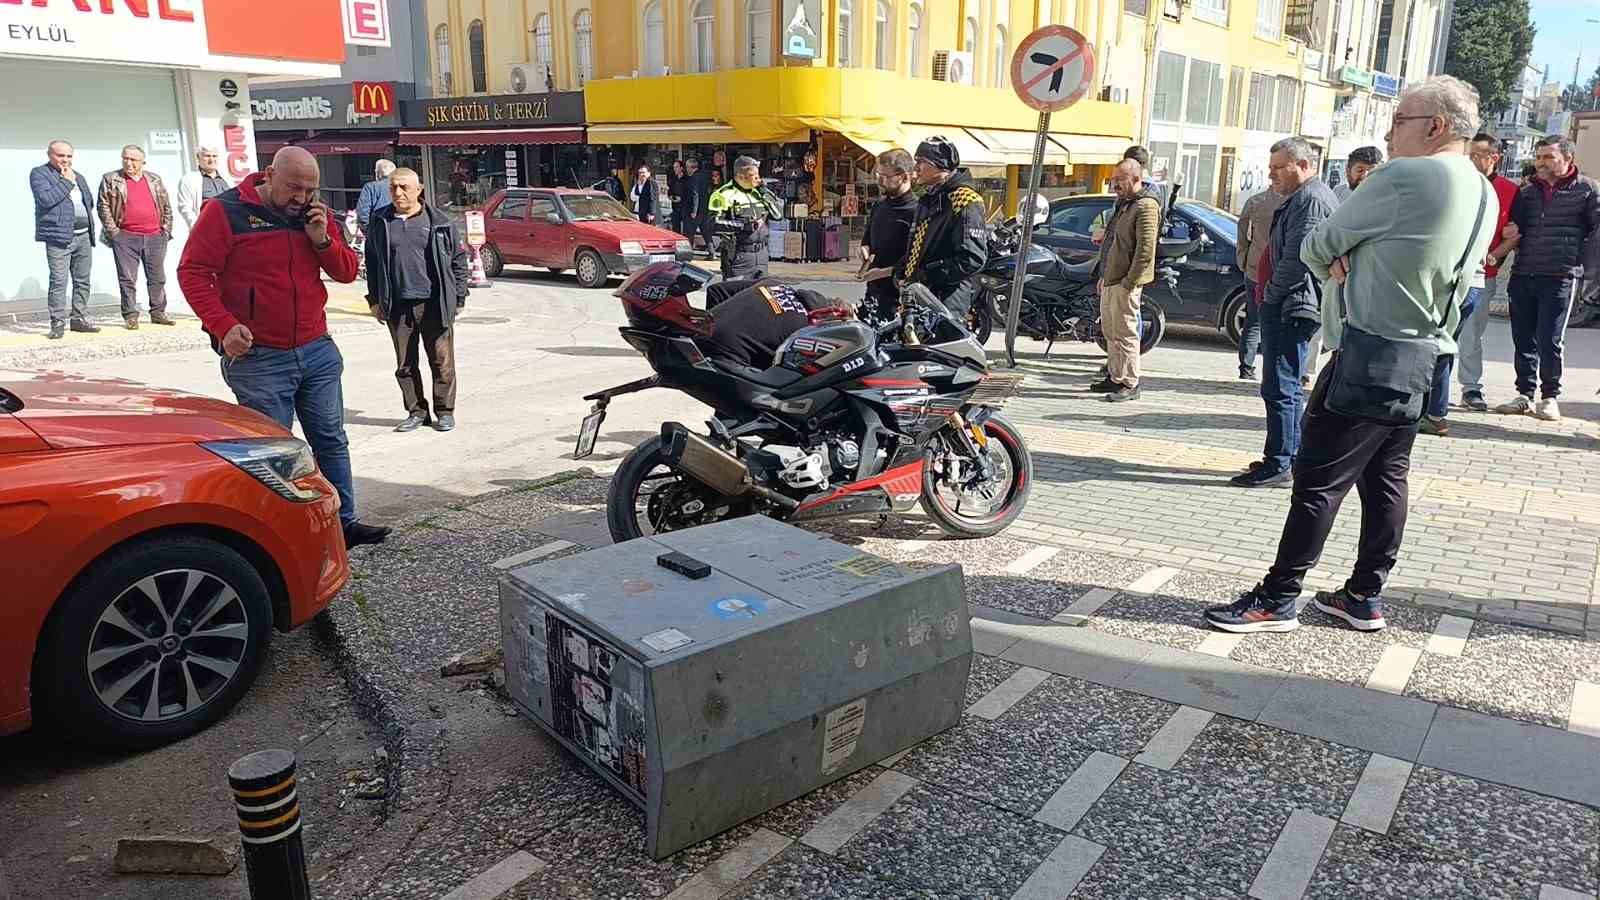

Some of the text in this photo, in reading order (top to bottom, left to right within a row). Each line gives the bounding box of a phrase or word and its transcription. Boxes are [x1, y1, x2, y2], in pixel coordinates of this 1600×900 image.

[354, 2, 379, 35] E
[8, 24, 75, 43] EYLÜL
[428, 98, 548, 127] ŞIK GİYİM & TERZİ
